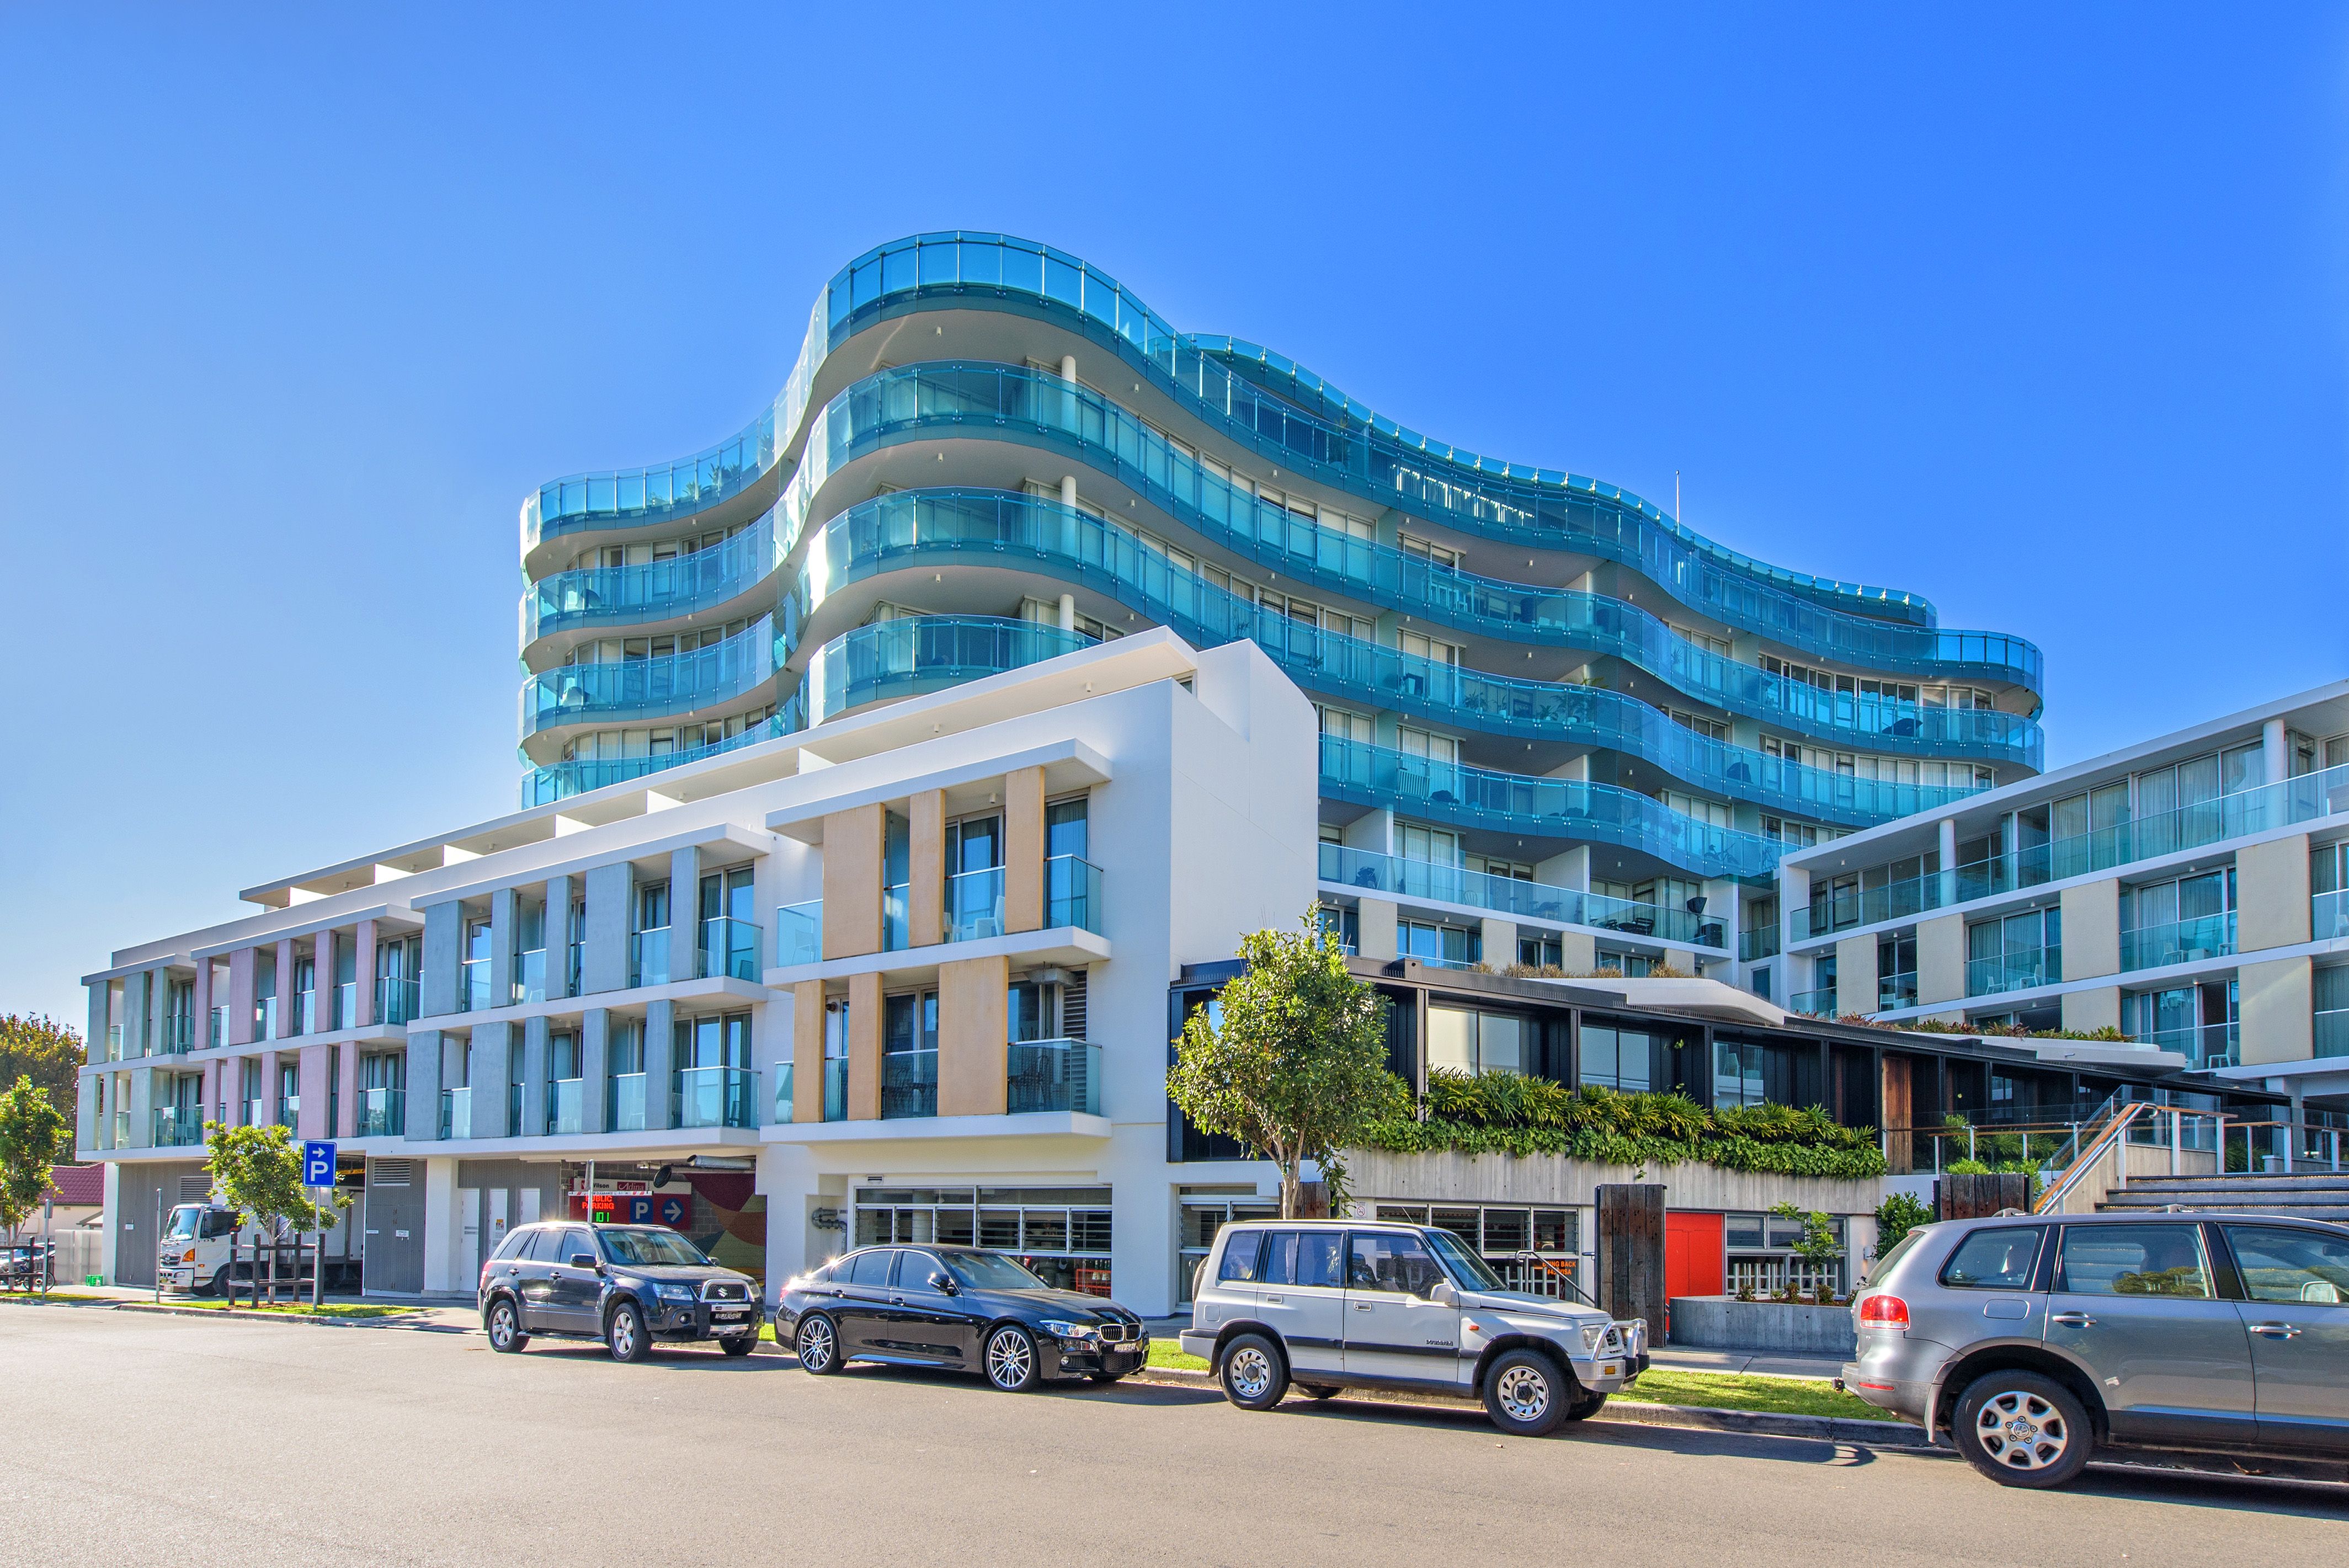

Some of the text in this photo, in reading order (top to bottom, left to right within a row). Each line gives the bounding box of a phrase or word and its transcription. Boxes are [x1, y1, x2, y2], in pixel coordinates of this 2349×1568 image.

[310, 1161, 328, 1181] P
[618, 1182, 644, 1191] Adina
[636, 1202, 649, 1219] P
